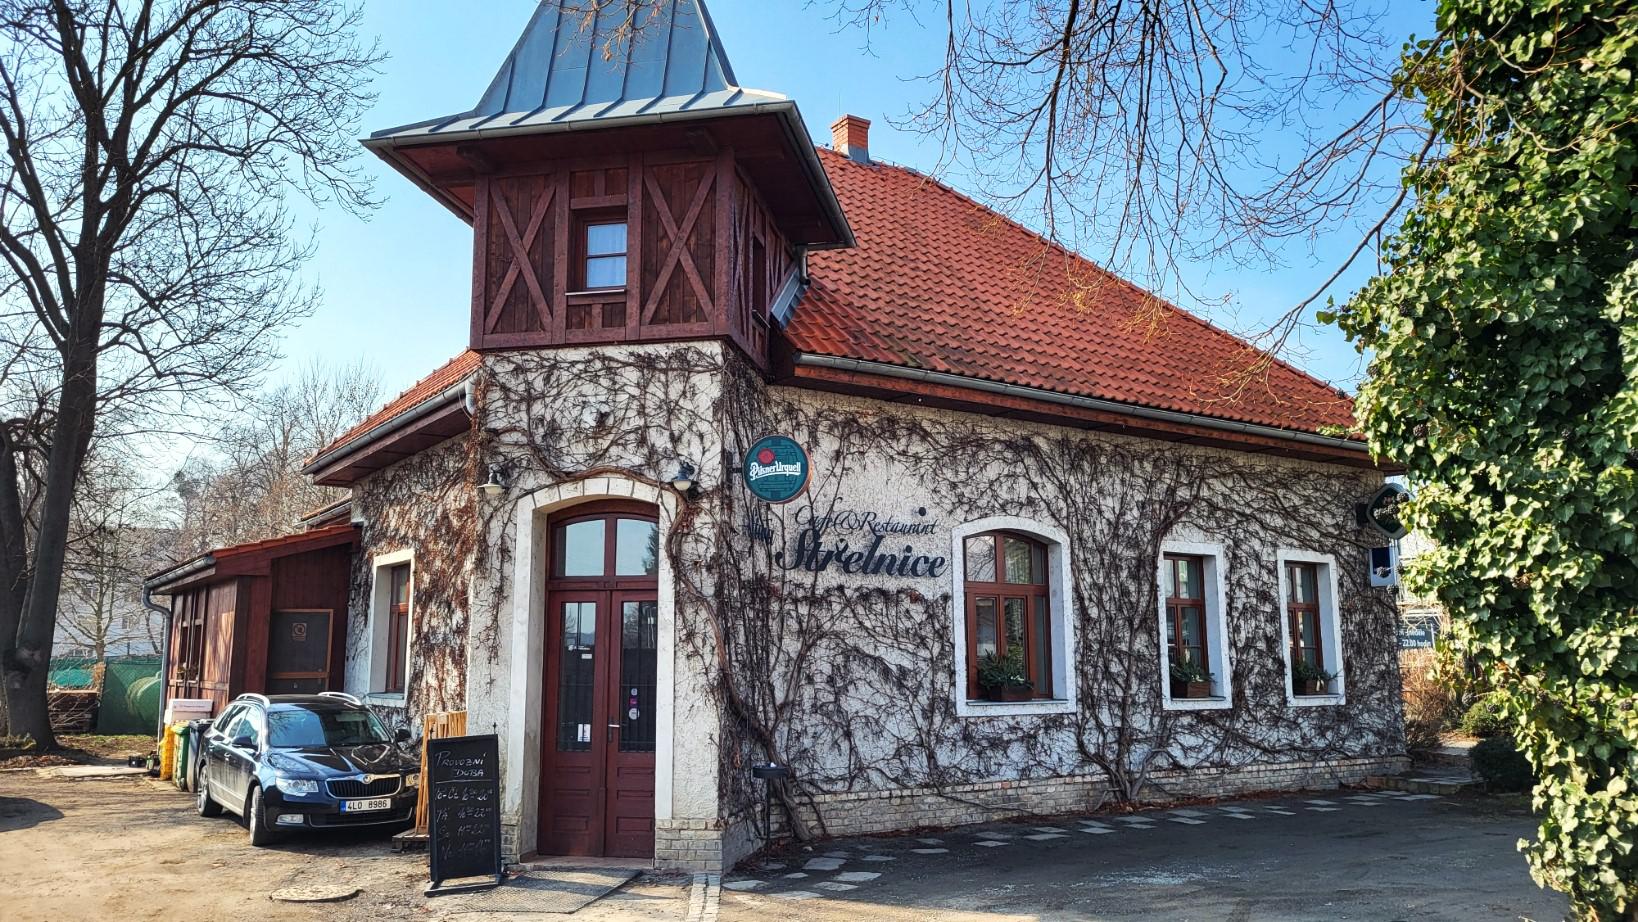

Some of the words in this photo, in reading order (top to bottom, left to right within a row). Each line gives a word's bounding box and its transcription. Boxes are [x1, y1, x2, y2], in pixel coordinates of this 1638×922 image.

[750, 462, 776, 480] Pilsner
[775, 461, 801, 476] Urquell
[775, 527, 949, 578] Střelnice
[453, 769, 484, 778] DOBA
